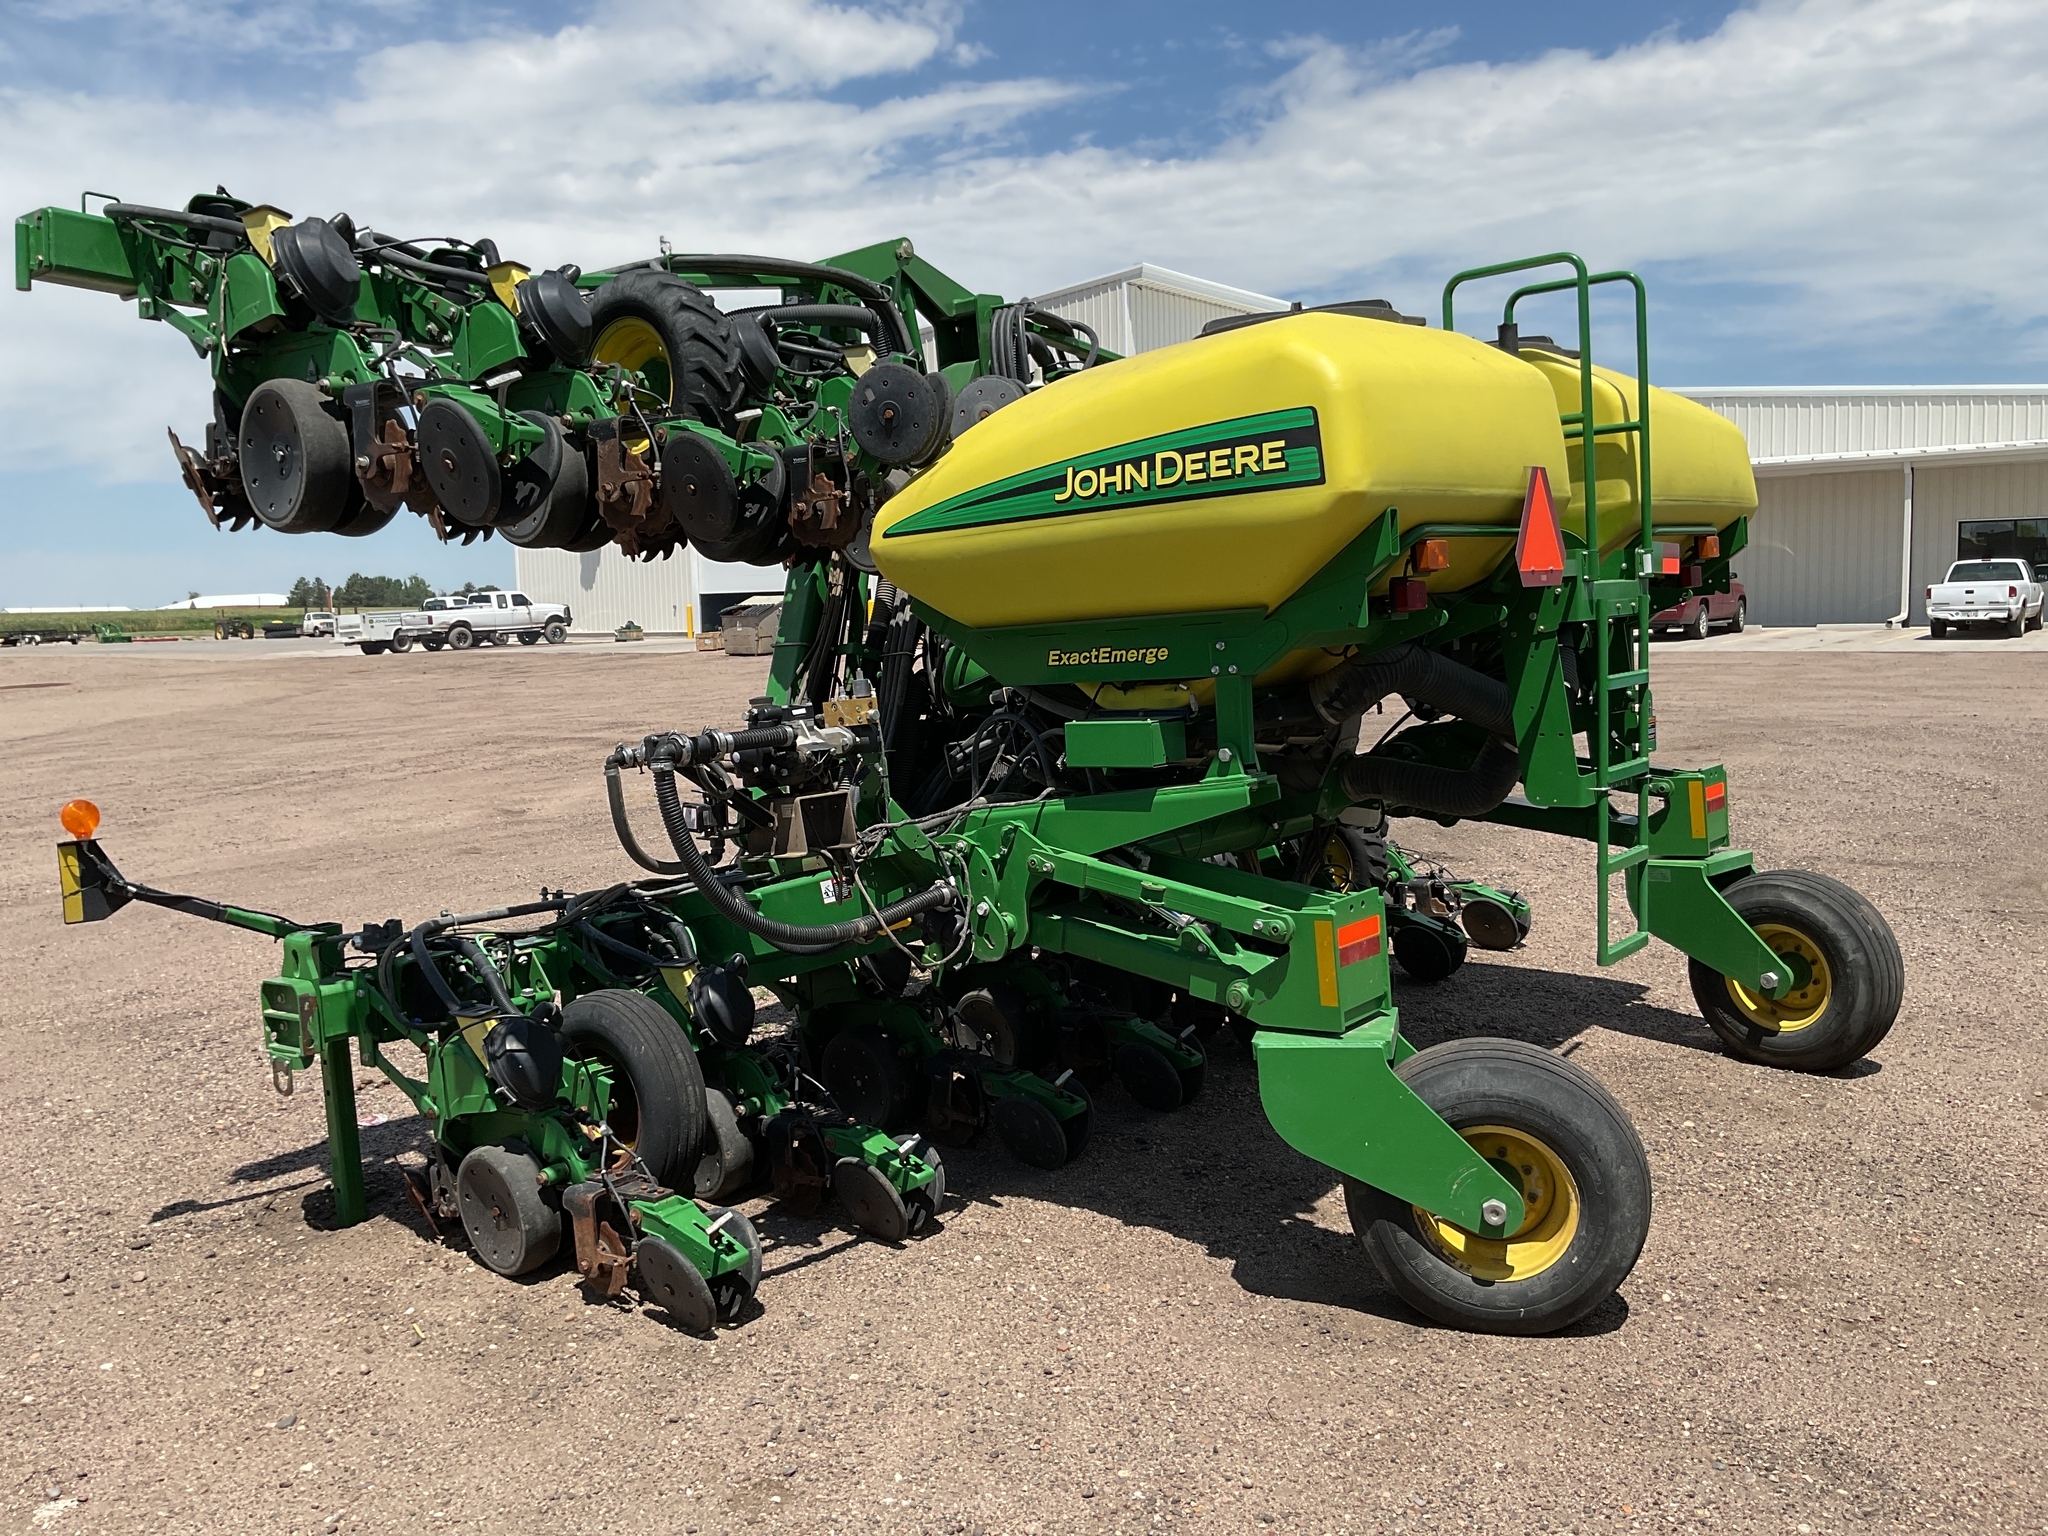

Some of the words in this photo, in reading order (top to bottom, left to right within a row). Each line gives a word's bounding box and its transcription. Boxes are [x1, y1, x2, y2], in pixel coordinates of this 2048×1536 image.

[1054, 460, 1149, 502] JOHN
[1155, 440, 1287, 487] DEERE
[1048, 647, 1169, 666] ExactEmerge
